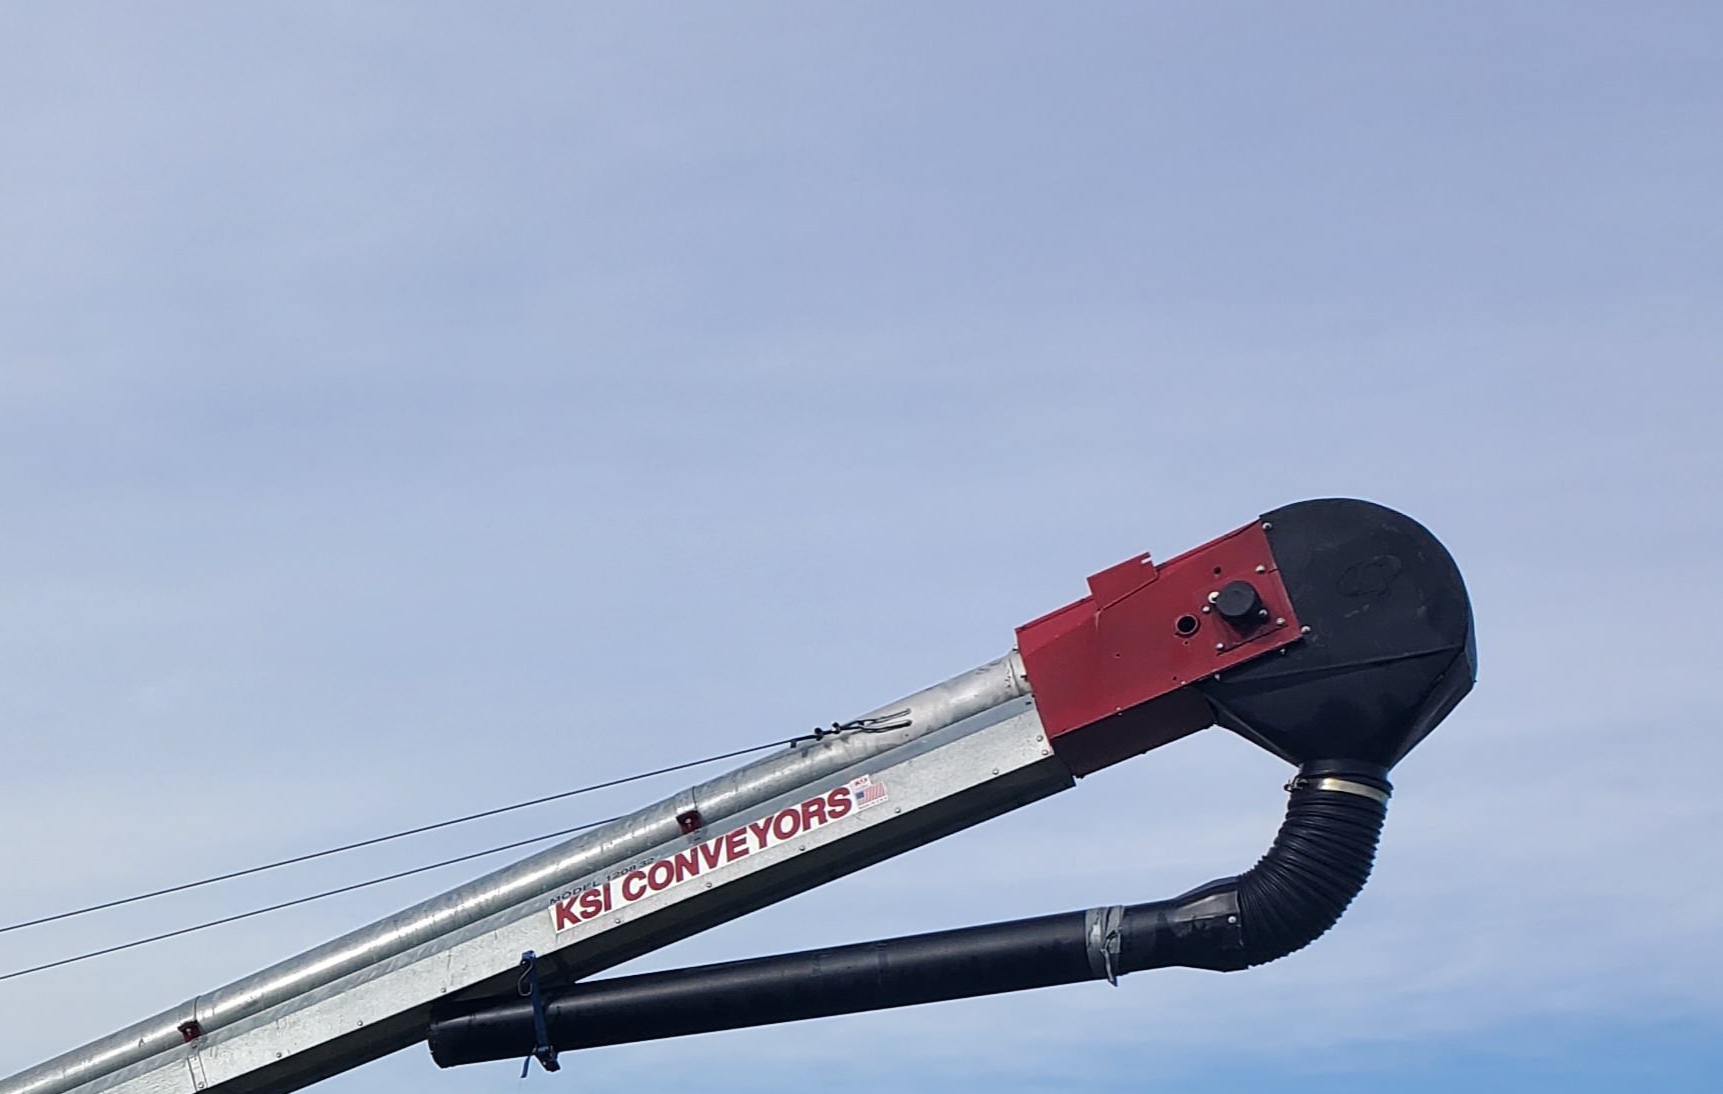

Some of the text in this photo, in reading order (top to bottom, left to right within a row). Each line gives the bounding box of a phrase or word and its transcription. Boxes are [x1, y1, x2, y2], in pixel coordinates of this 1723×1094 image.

[550, 880, 600, 905] MODEL
[556, 787, 852, 931] KSI CONVEYORS
